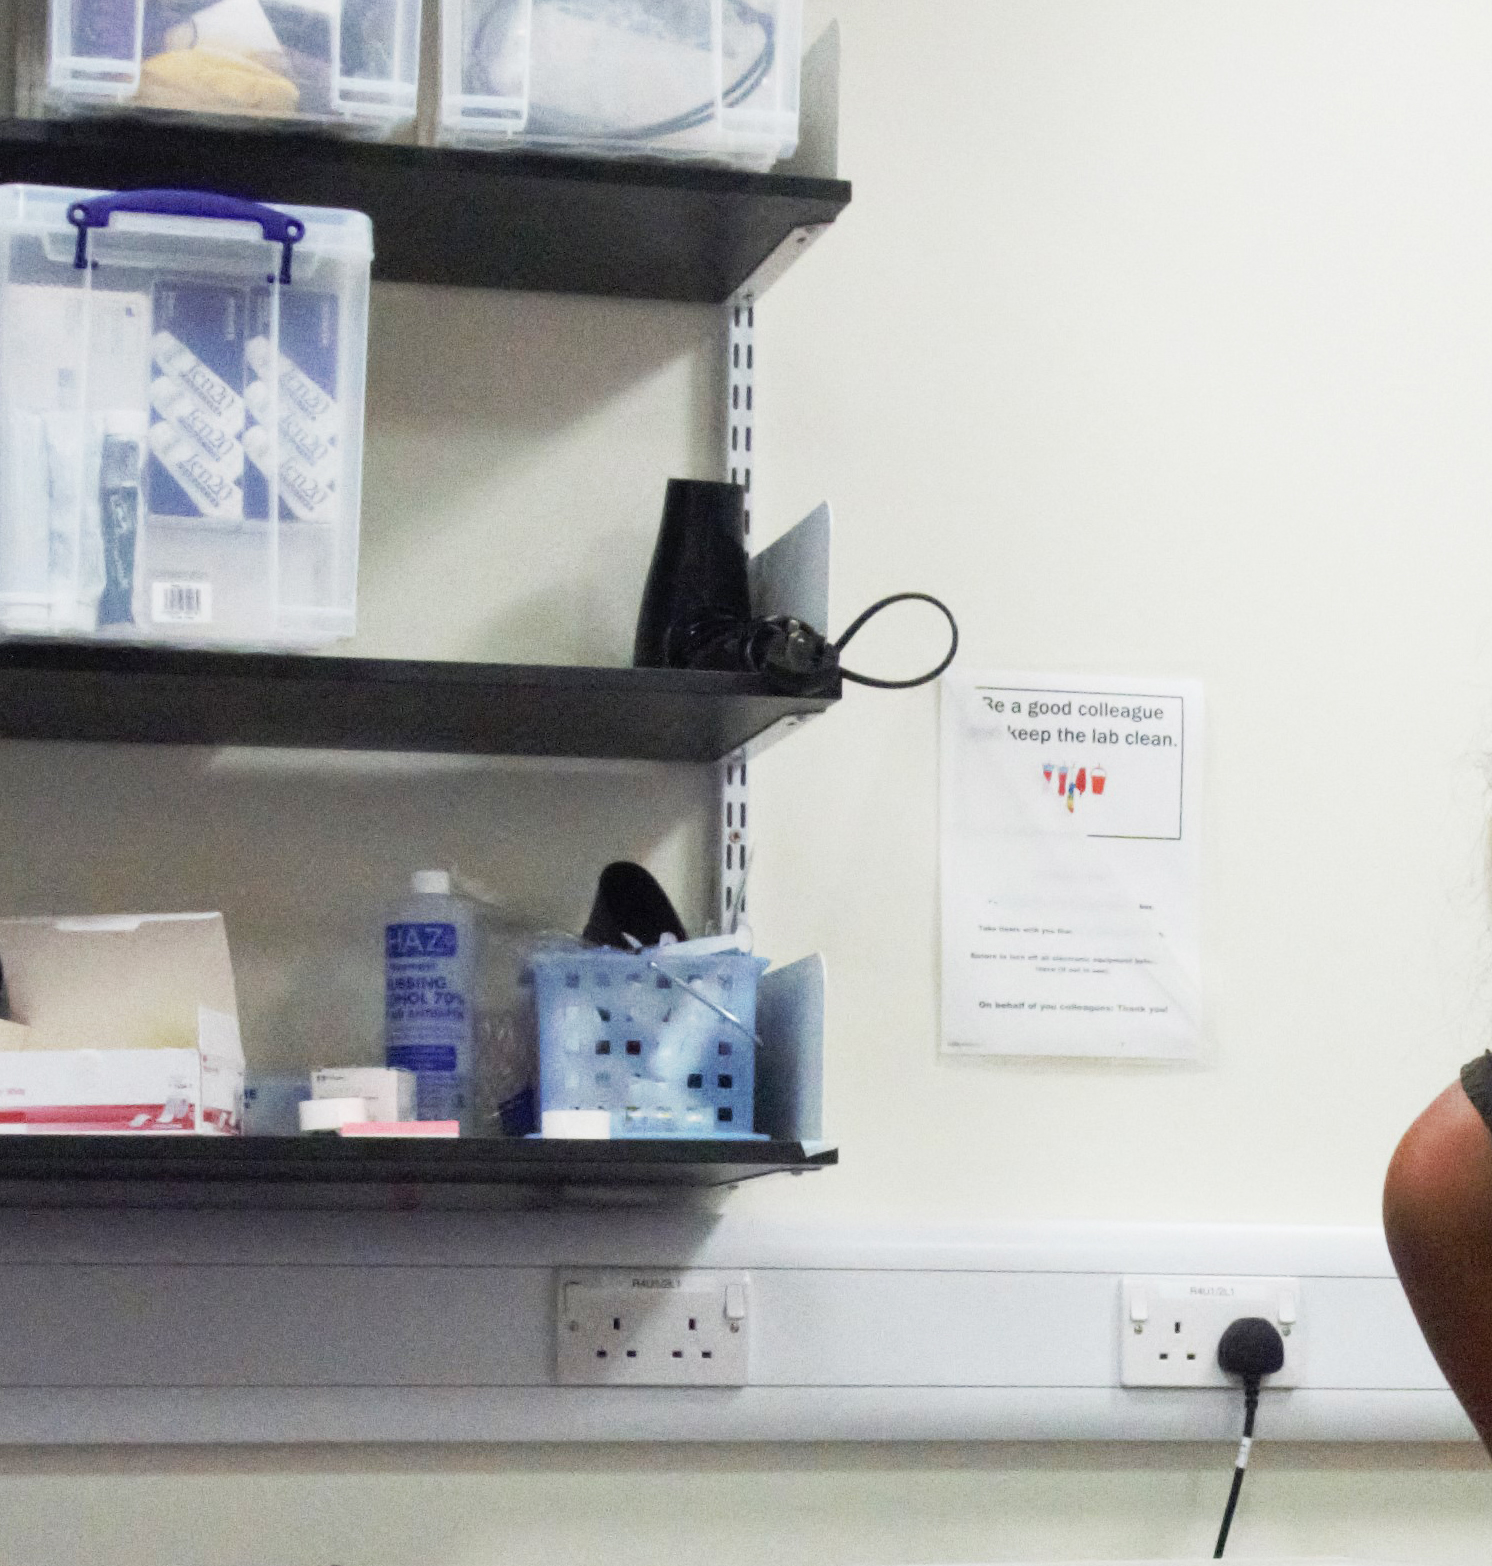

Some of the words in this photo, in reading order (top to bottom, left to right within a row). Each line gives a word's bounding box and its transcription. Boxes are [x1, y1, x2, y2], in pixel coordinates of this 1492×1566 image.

[1012, 703, 1021, 714] a
[1028, 700, 1072, 718] good
[1078, 703, 1164, 722] colleague
[1058, 727, 1086, 743] the
[1092, 729, 1119, 744] lab
[1125, 731, 1178, 747] clean.
[979, 1001, 992, 1009] On
[995, 1001, 1024, 1010] behalf
